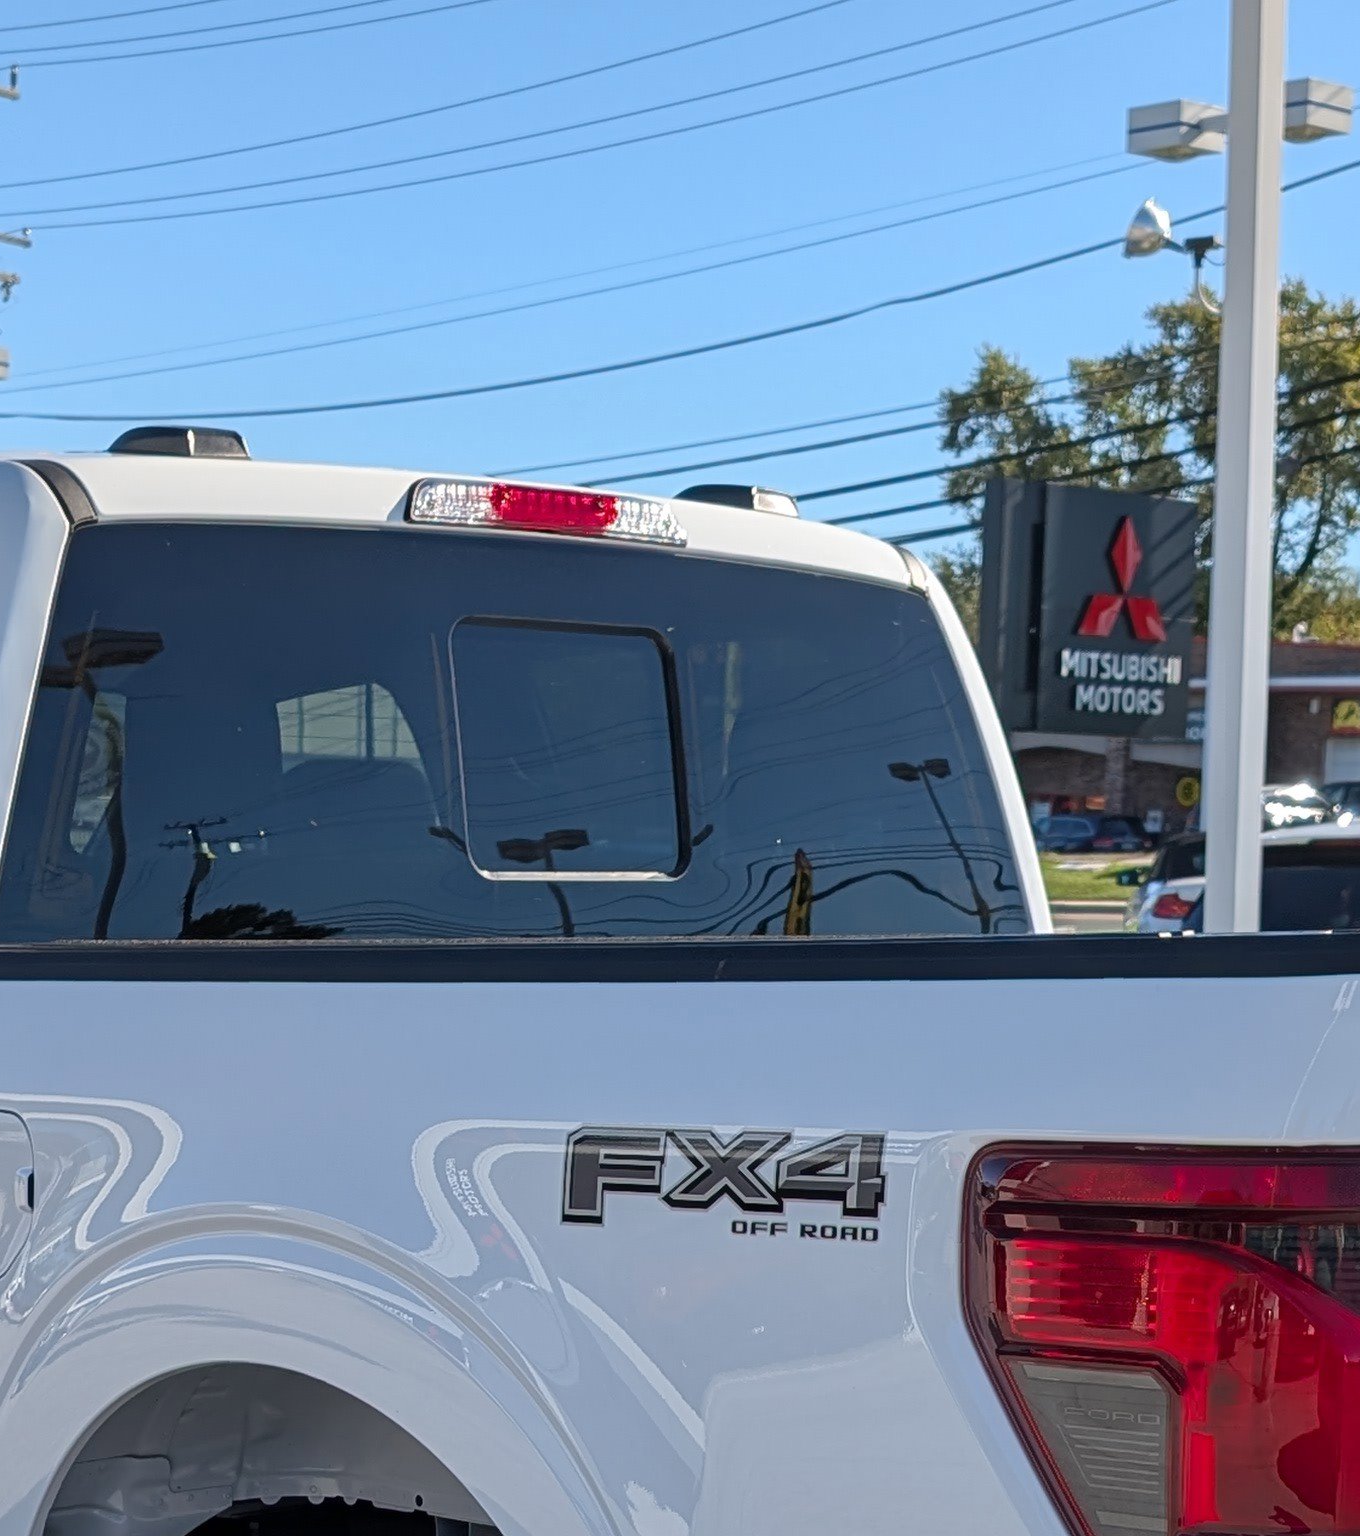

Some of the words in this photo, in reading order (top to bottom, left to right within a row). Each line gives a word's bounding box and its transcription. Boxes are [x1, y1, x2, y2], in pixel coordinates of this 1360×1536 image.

[1060, 649, 1182, 685] MITSUBISHI
[1075, 684, 1165, 716] MOTORS
[560, 1125, 887, 1227] FX4
[731, 1220, 789, 1238] OFF
[800, 1223, 879, 1242] ROAD
[1063, 1406, 1161, 1425] FORD
